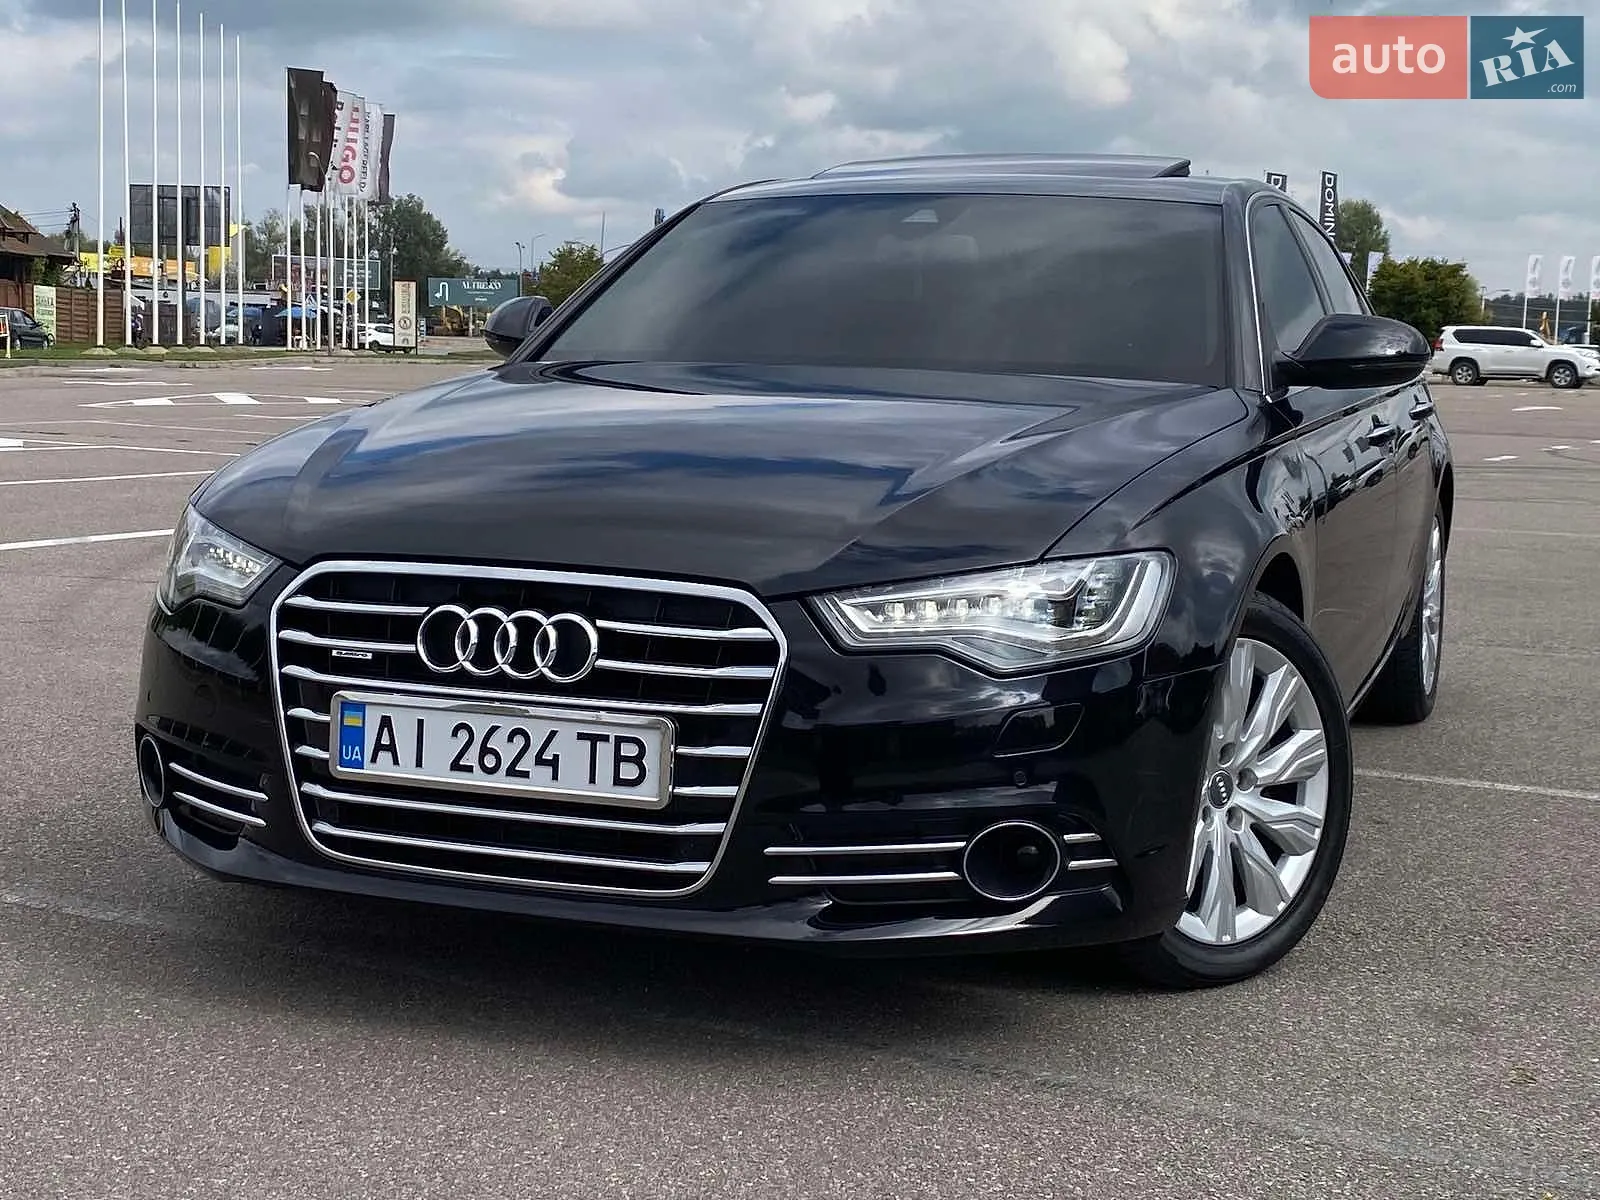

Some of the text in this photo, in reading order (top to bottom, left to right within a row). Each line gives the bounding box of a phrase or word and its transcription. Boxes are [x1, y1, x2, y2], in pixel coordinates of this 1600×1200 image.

[342, 744, 362, 762] UA
[370, 714, 648, 788] AI 2624 TB
